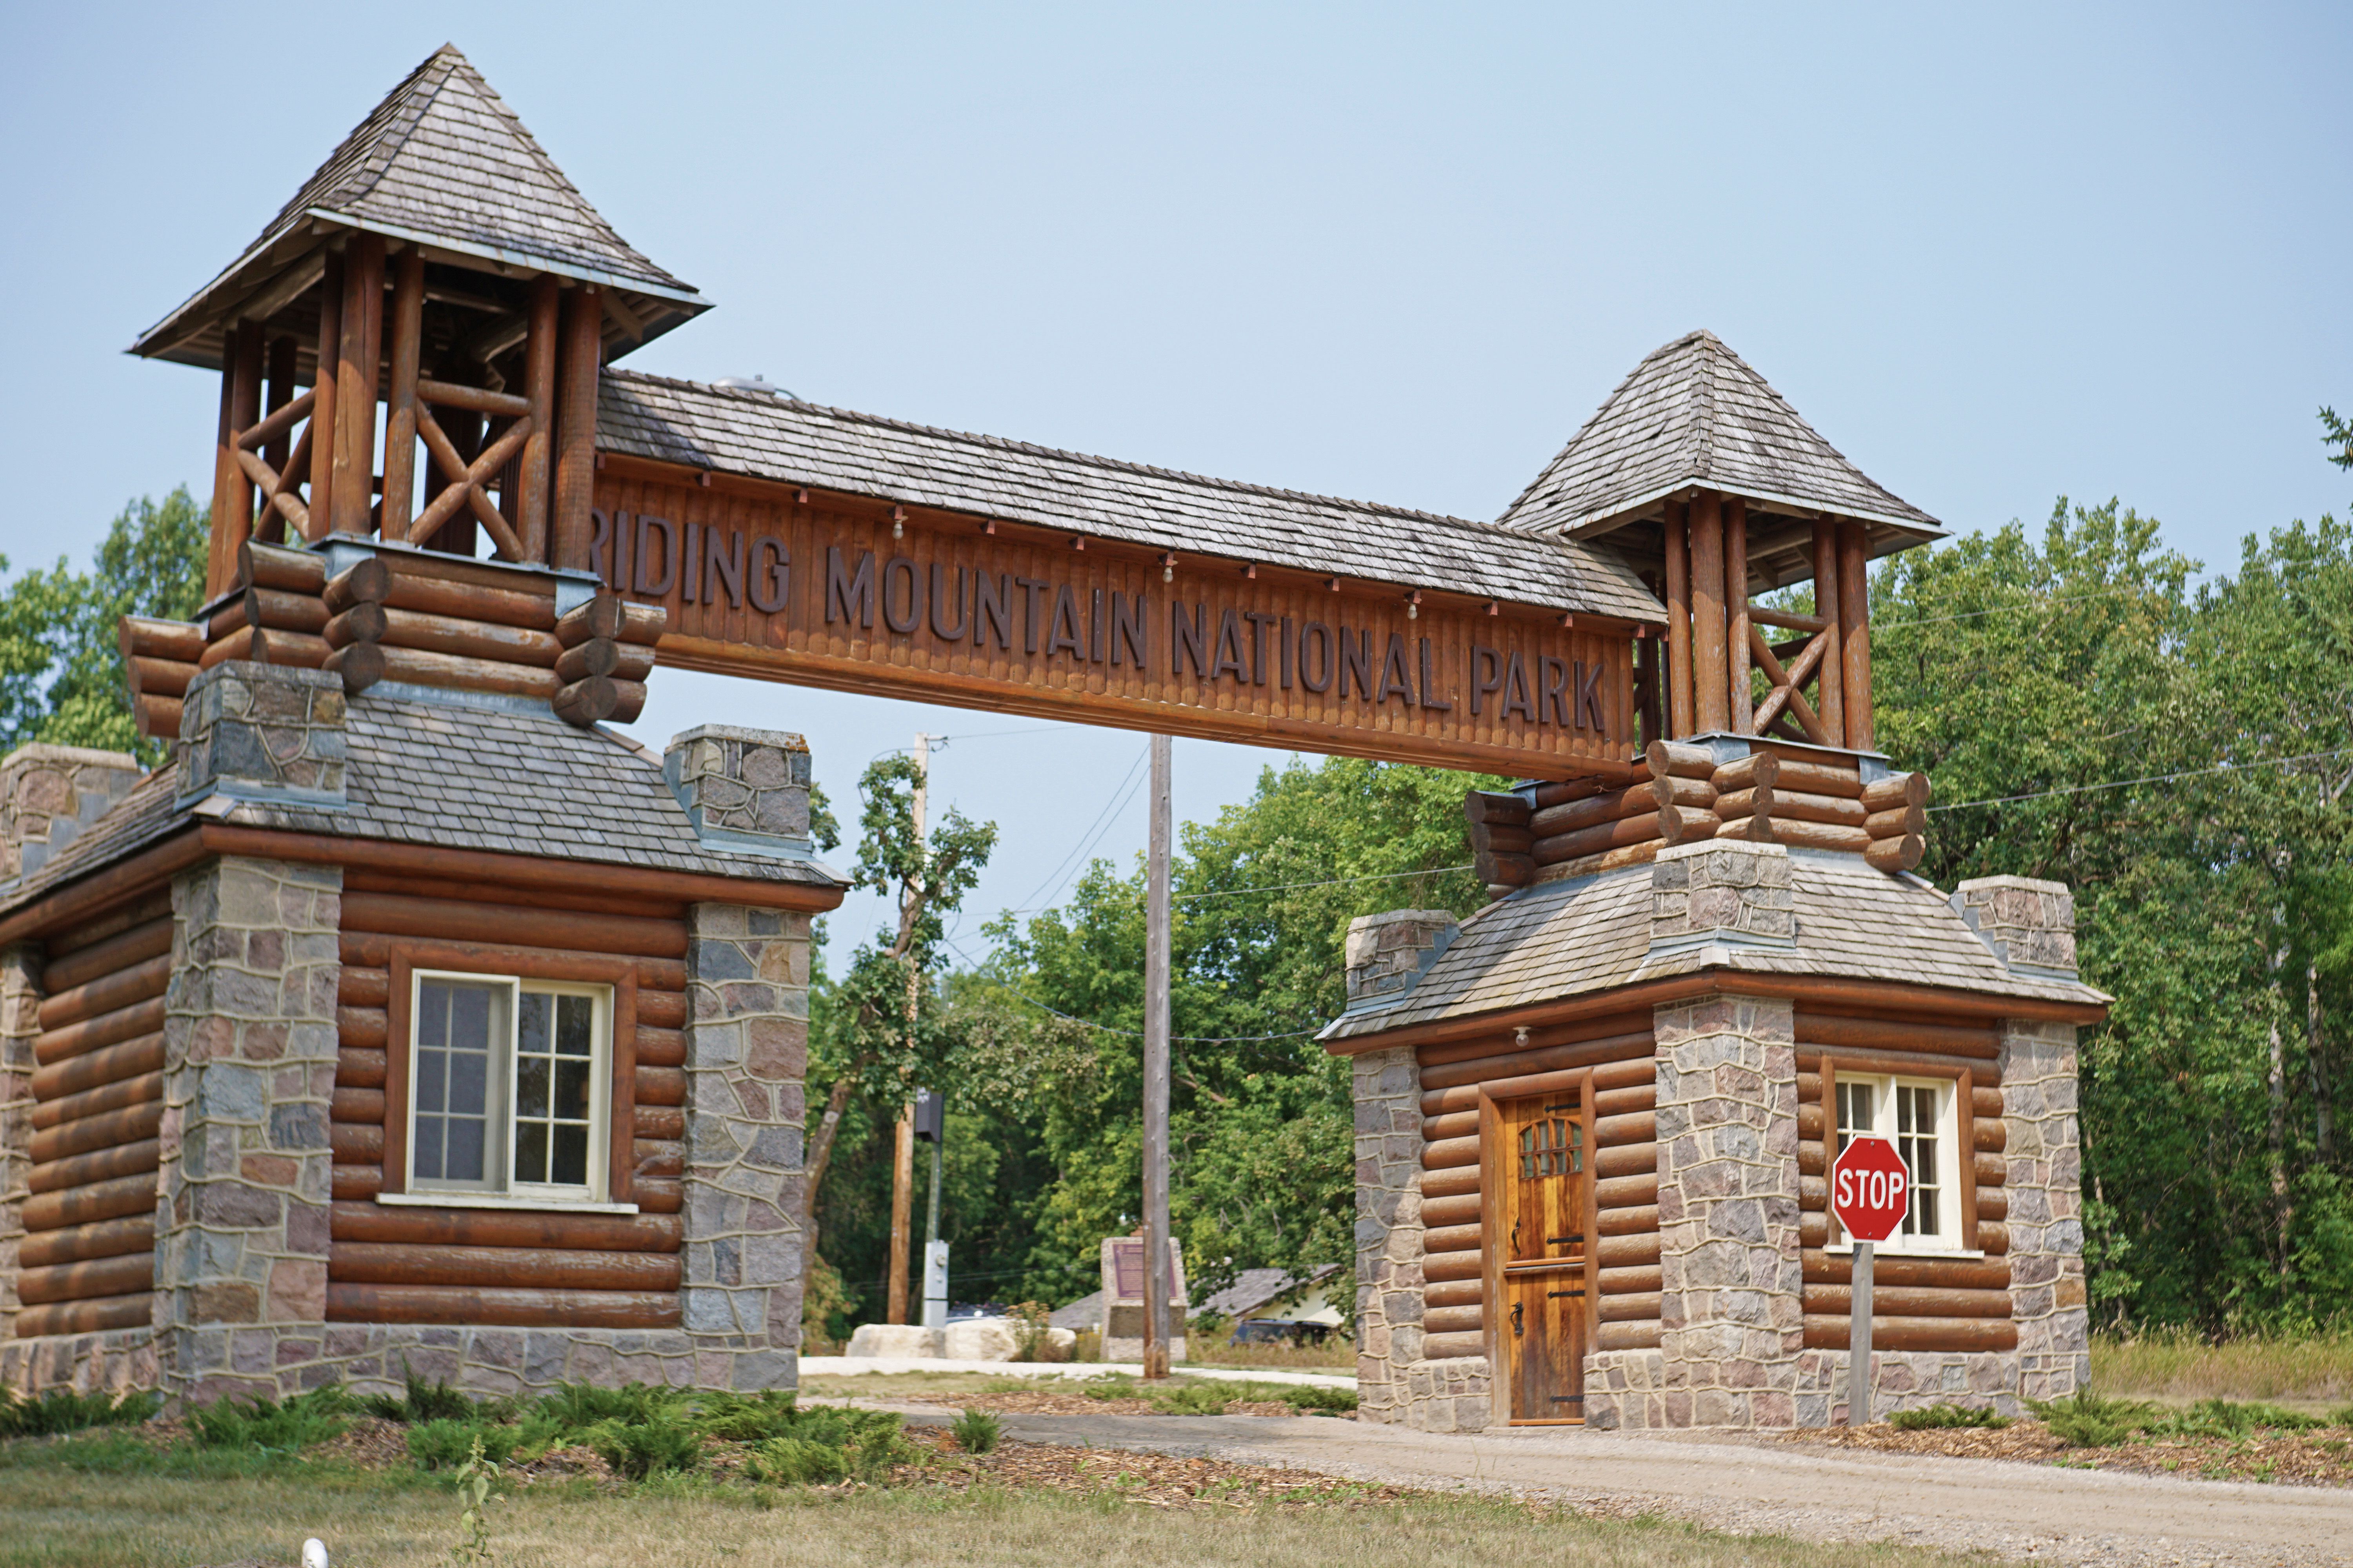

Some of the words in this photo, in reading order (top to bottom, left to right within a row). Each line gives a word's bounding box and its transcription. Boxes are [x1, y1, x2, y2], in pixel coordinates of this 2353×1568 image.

[590, 507, 790, 614] RIDING
[825, 546, 1147, 669] MOUNTAIN
[1172, 601, 1452, 710] NATIONAL
[1470, 645, 1604, 731] PARK
[1837, 1168, 1904, 1210] STOP
